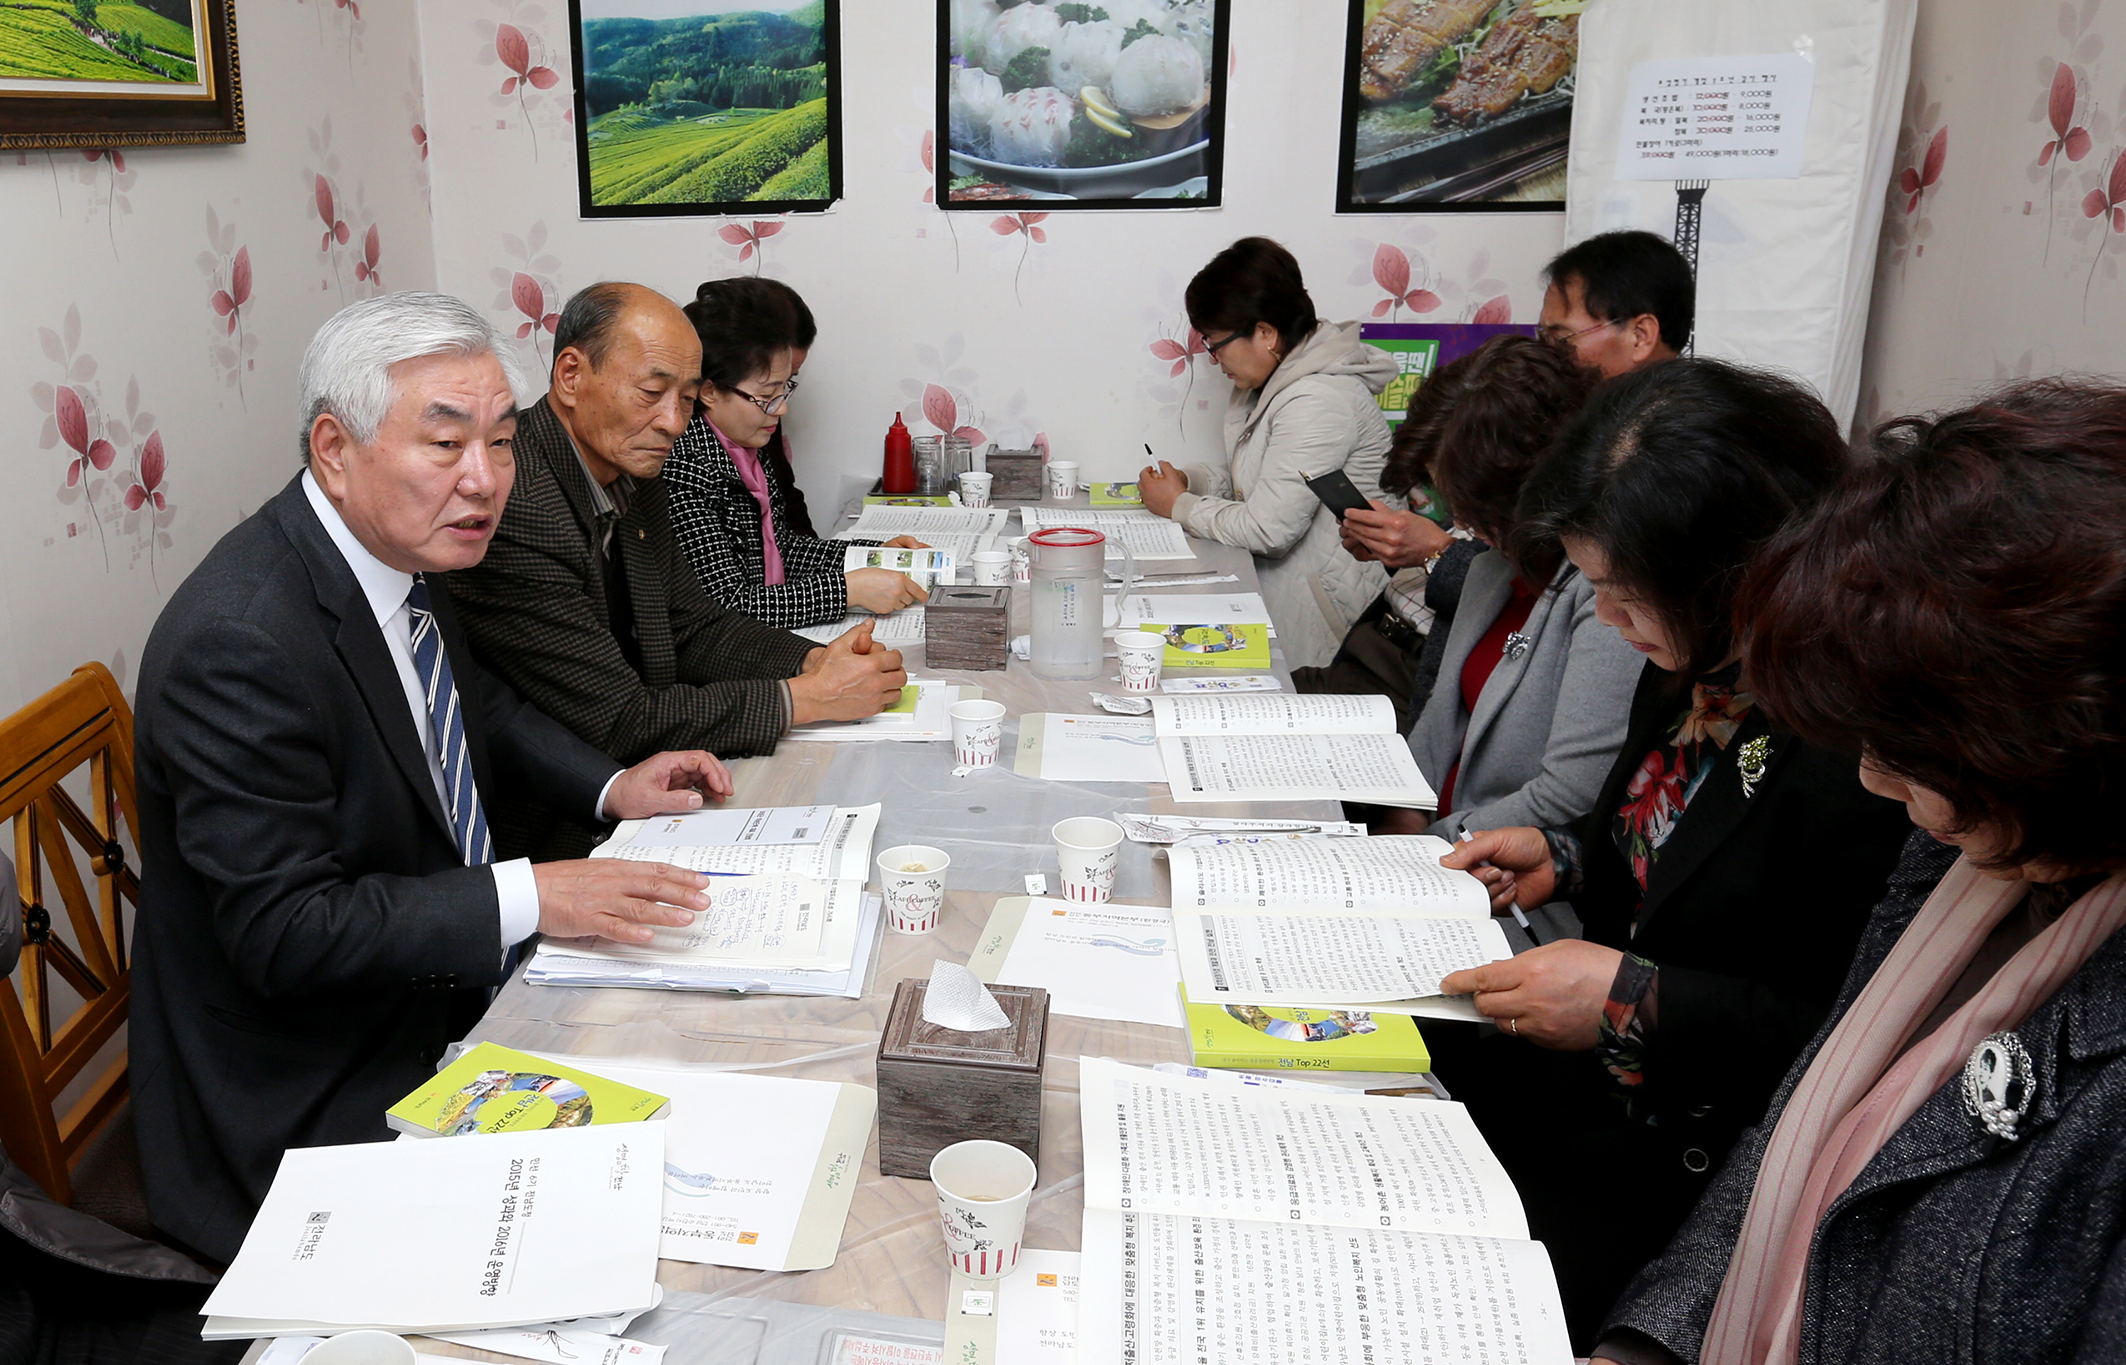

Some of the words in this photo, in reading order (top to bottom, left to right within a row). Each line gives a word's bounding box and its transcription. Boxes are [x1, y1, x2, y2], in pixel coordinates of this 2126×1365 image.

[1278, 1057, 1294, 1068] 전남
[1296, 1058, 1311, 1068] Top
[1312, 1059, 1330, 1069] 22선
[528, 1157, 540, 1171] 민선
[504, 1158, 523, 1190] 2015년
[526, 1175, 537, 1186] 6기
[498, 1195, 516, 1222] 성과와
[521, 1190, 535, 1217] 전남도정
[1125, 1225, 1134, 1238] 복지
[1192, 1223, 1201, 1233] 환경
[1259, 1230, 1268, 1240] 조성
[300, 1225, 324, 1259] 전라남도
[490, 1226, 510, 1255] 2016년
[1211, 1236, 1221, 1254] 가정의
[1261, 1243, 1270, 1255] 문화
[1348, 1237, 1359, 1248] 선도
[1125, 1242, 1135, 1265] 맞춤형
[1152, 1245, 1160, 1271] 서비스로
[1166, 1255, 1175, 1288] 관리체계를
[1213, 1257, 1222, 1270] 출산
[1279, 1262, 1288, 1274] 양립
[1351, 1251, 1363, 1281] 노인복지
[480, 1260, 502, 1296] 운영방향
[1153, 1273, 1161, 1287] 복지
[1194, 1269, 1204, 1284] 위한
[1262, 1259, 1273, 1288] 출산장려
[1313, 1267, 1323, 1297] 확충하고,
[1427, 1270, 1439, 1292] 알선과
[1481, 1265, 1494, 1292] 거점으로
[1501, 1271, 1510, 1284] 위치
[1124, 1270, 1135, 1297] 대응한
[1214, 1274, 1223, 1303] 조성하고
[1232, 1282, 1240, 1297] 설치,
[1247, 1281, 1255, 1294] 지원
[1373, 1268, 1386, 1303] 공동생활의
[1390, 1267, 1404, 1316] 확대(100개소)로
[1446, 1269, 1460, 1298] 독거노인
[1153, 1291, 1162, 1311] 맞춤형
[1195, 1289, 1204, 1313] 유지를
[1355, 1285, 1367, 1309] 맞춤형
[1468, 1285, 1476, 1301] 확인,
[1505, 1288, 1515, 1308] 예방용
[1166, 1292, 1175, 1313] 감염병
[1233, 1301, 1241, 1319] 2호점
[1265, 1292, 1275, 1323] 협업하여
[1298, 1299, 1306, 1312] 직원
[1431, 1297, 1443, 1320] 재취업
[1452, 1303, 1463, 1319] 재가
[1471, 1304, 1481, 1319] 안부
[1195, 1317, 1205, 1330] 1위
[1215, 1306, 1225, 1328] 환경을
[1378, 1308, 1388, 1324] 노인
[1509, 1312, 1520, 1326] 실종
[1153, 1315, 1162, 1336] 확충과
[1284, 1321, 1293, 1347] 육아휴직
[1299, 1315, 1309, 1341] 공공기관
[1359, 1314, 1370, 1340] 부응한
[1397, 1321, 1408, 1337] 설치
[1456, 1323, 1466, 1339] 위해
[1474, 1323, 1484, 1336] 통해
[1167, 1328, 1175, 1342] 의료
[1196, 1335, 1206, 1352] 전국
[1216, 1332, 1226, 1347] 좋은
[1380, 1328, 1392, 1352] 가능한
[871, 1343, 900, 1356] 이탈시켜
[903, 1347, 932, 1360] 부탄캔을
[1153, 1340, 1162, 1361] 안전망
[1167, 1346, 1176, 1360] 응급
[1498, 1350, 1509, 1364] 순천
